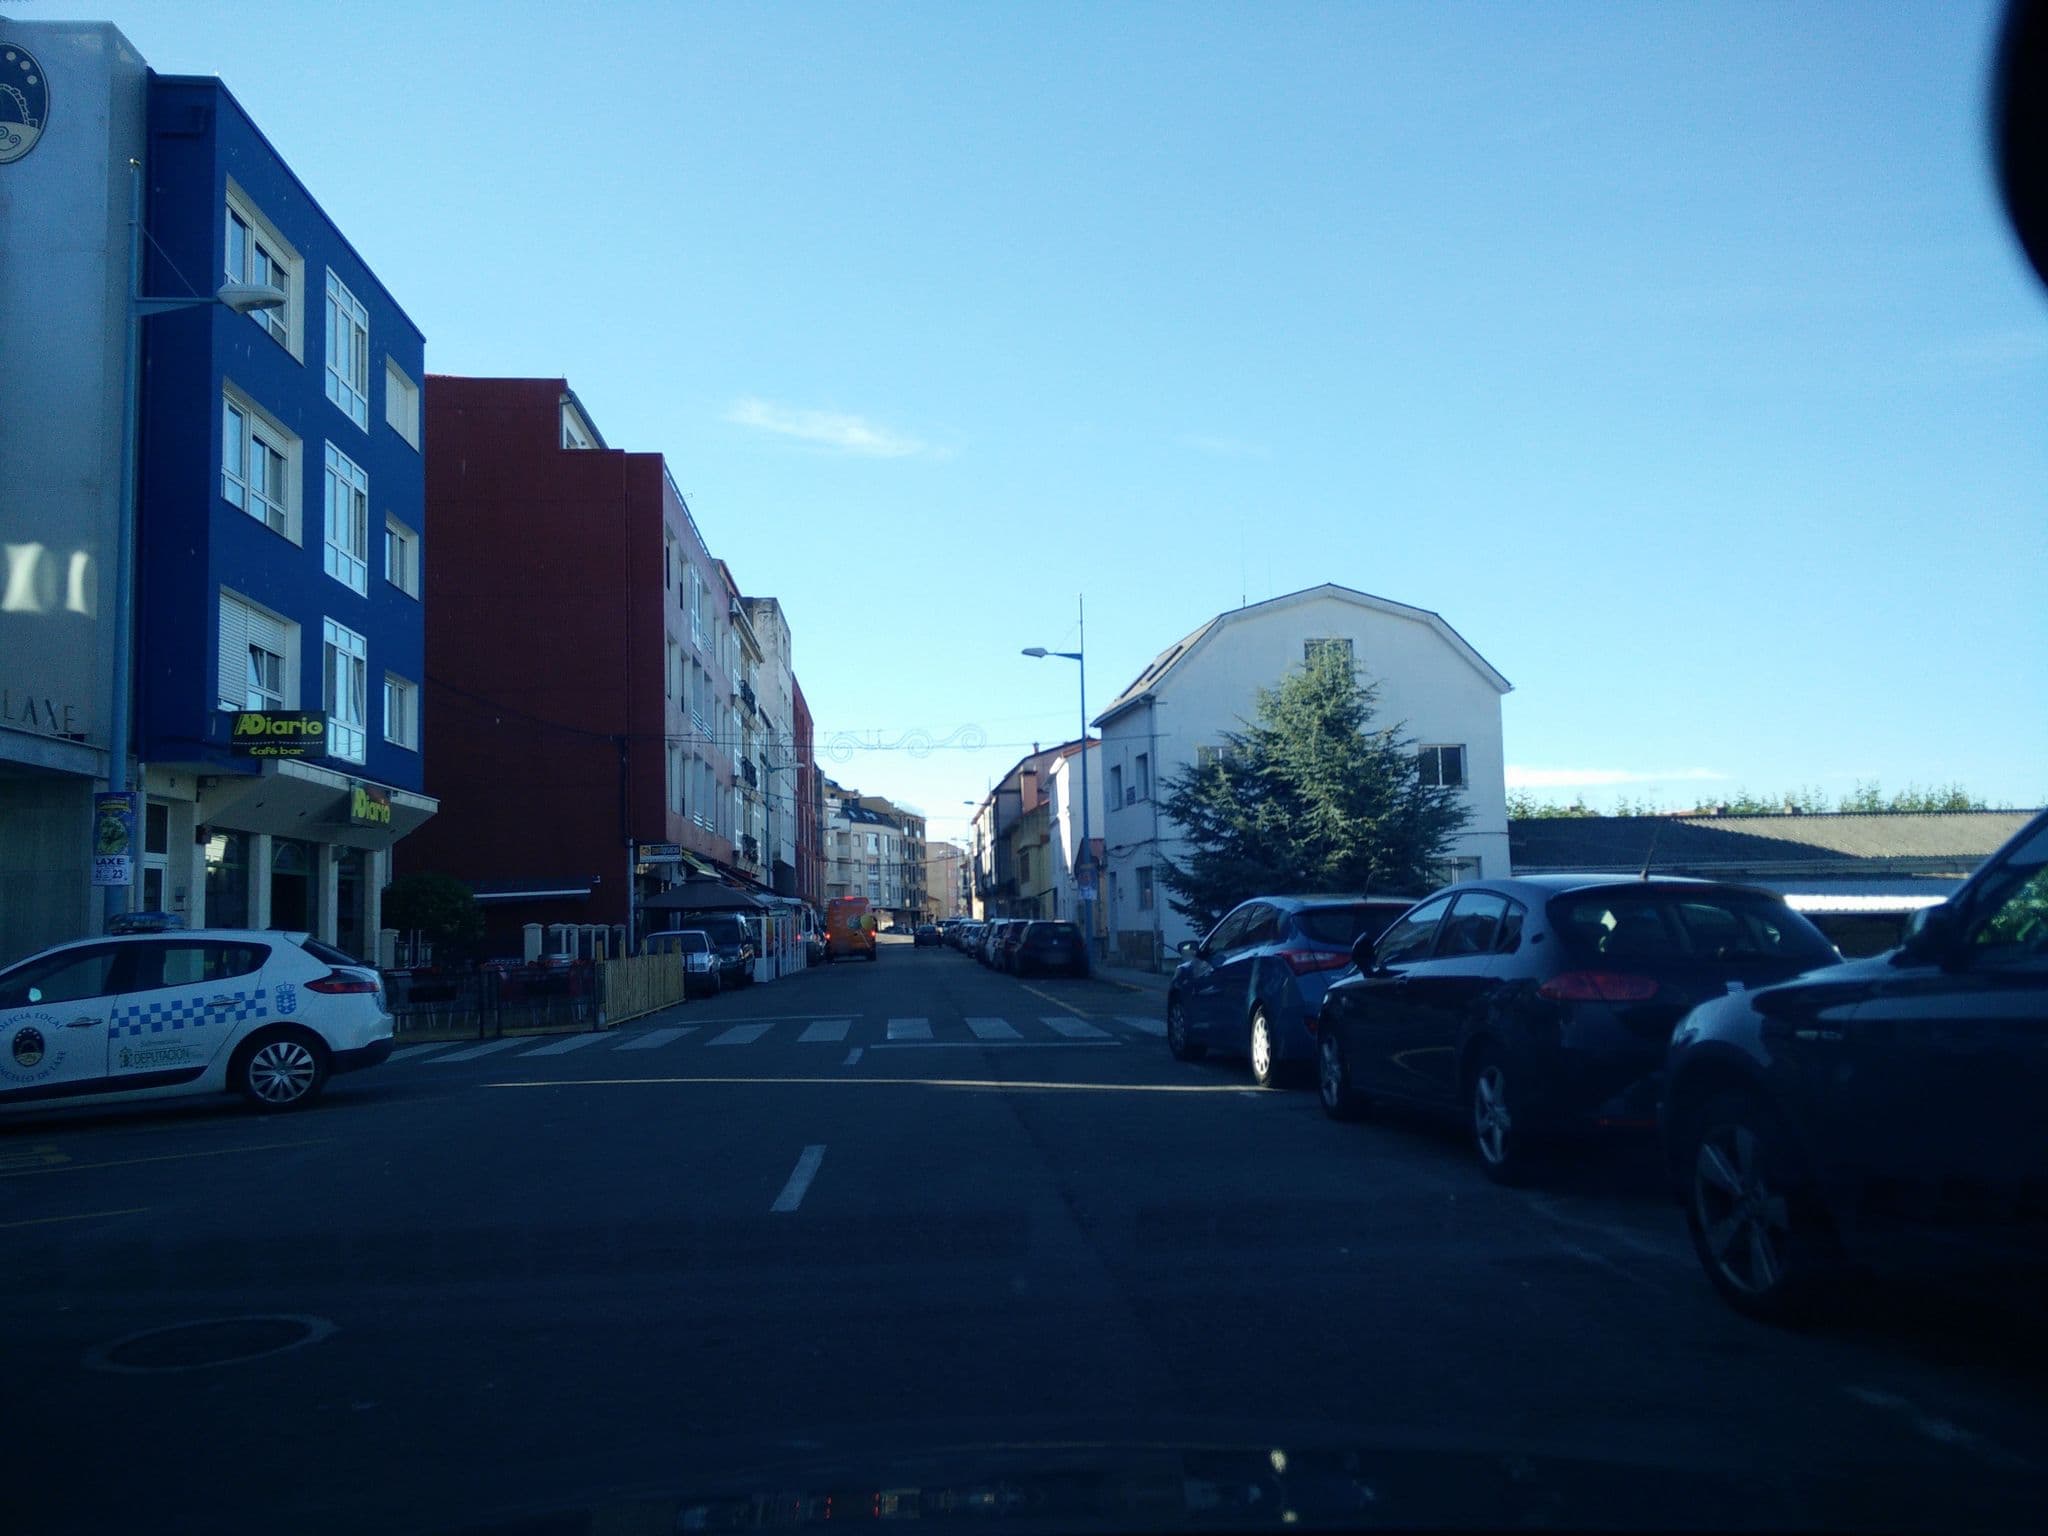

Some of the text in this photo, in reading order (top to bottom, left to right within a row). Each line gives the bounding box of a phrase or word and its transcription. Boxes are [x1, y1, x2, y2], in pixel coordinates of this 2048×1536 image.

[234, 713, 323, 736] ADiario
[280, 746, 305, 755] bar
[96, 857, 125, 866] LAXE
[112, 869, 123, 879] 23
[0, 1012, 31, 1032] OLICIA
